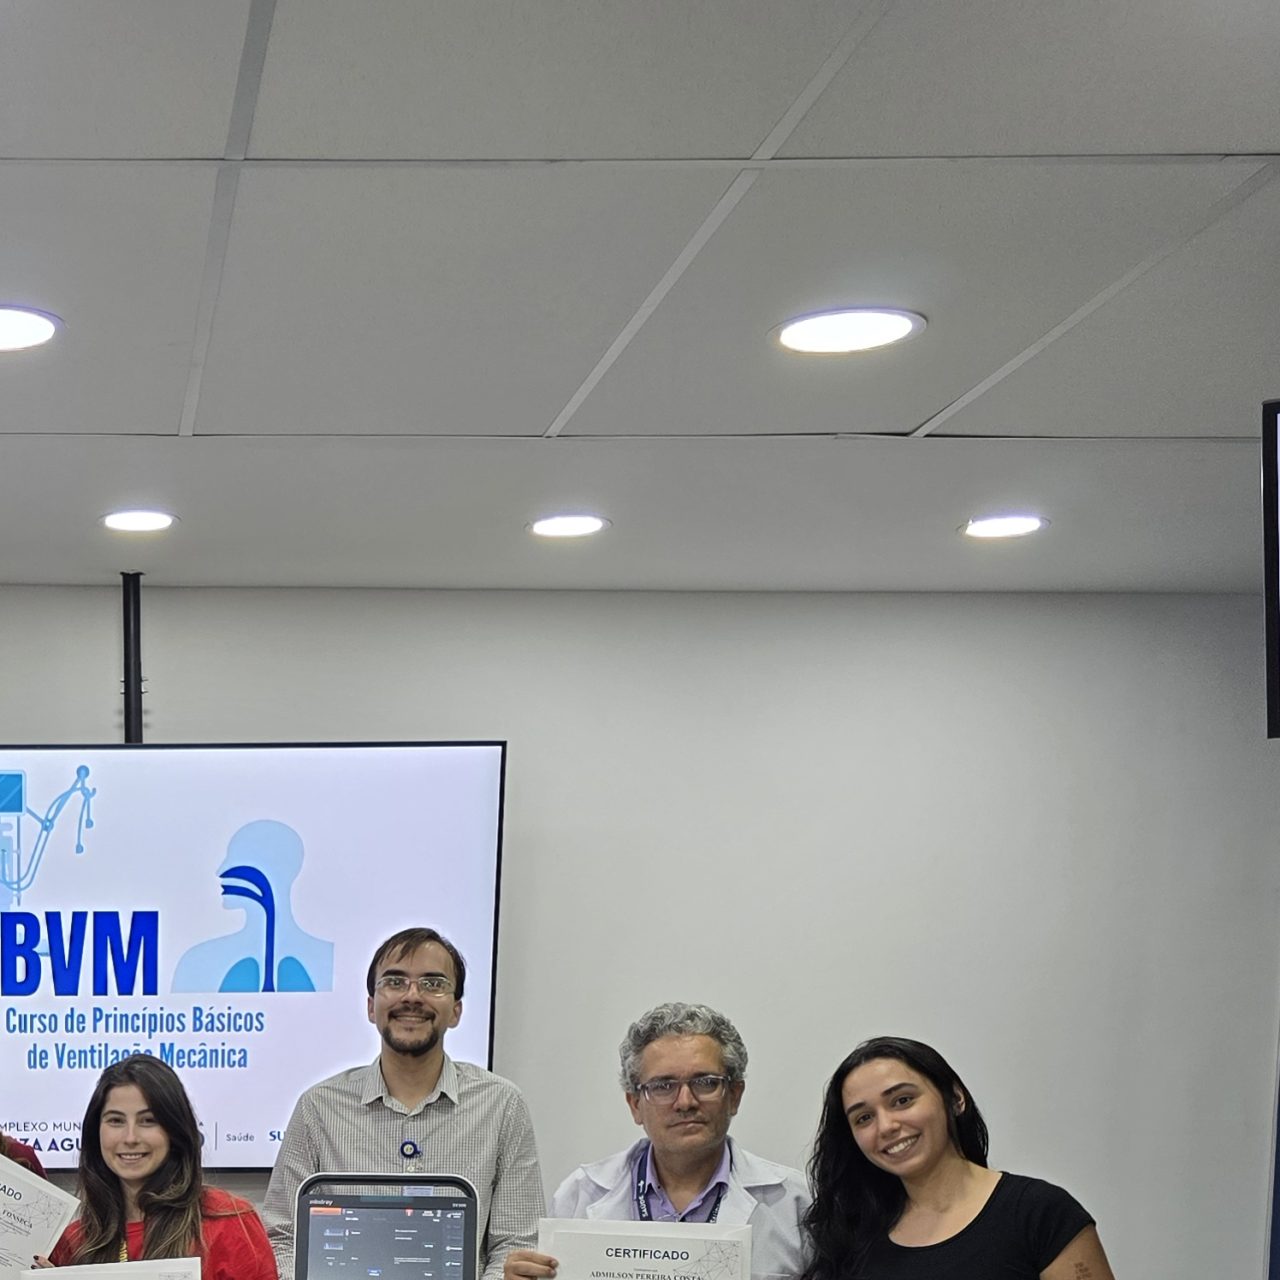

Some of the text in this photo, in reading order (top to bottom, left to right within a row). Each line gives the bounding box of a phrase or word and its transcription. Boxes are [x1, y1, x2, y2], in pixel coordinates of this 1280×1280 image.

[5, 1006, 265, 1039] Curso de Princípios Básicos
[27, 1043, 49, 1069] de
[159, 1042, 248, 1069] Mecânica
[52, 1121, 82, 1132] MUN
[225, 1132, 255, 1142] Saúde
[268, 1130, 284, 1142] SU
[605, 1247, 690, 1261] CERTIFICADO
[590, 1270, 634, 1279] ADMILSON
[635, 1273, 671, 1280] PEREIRA
